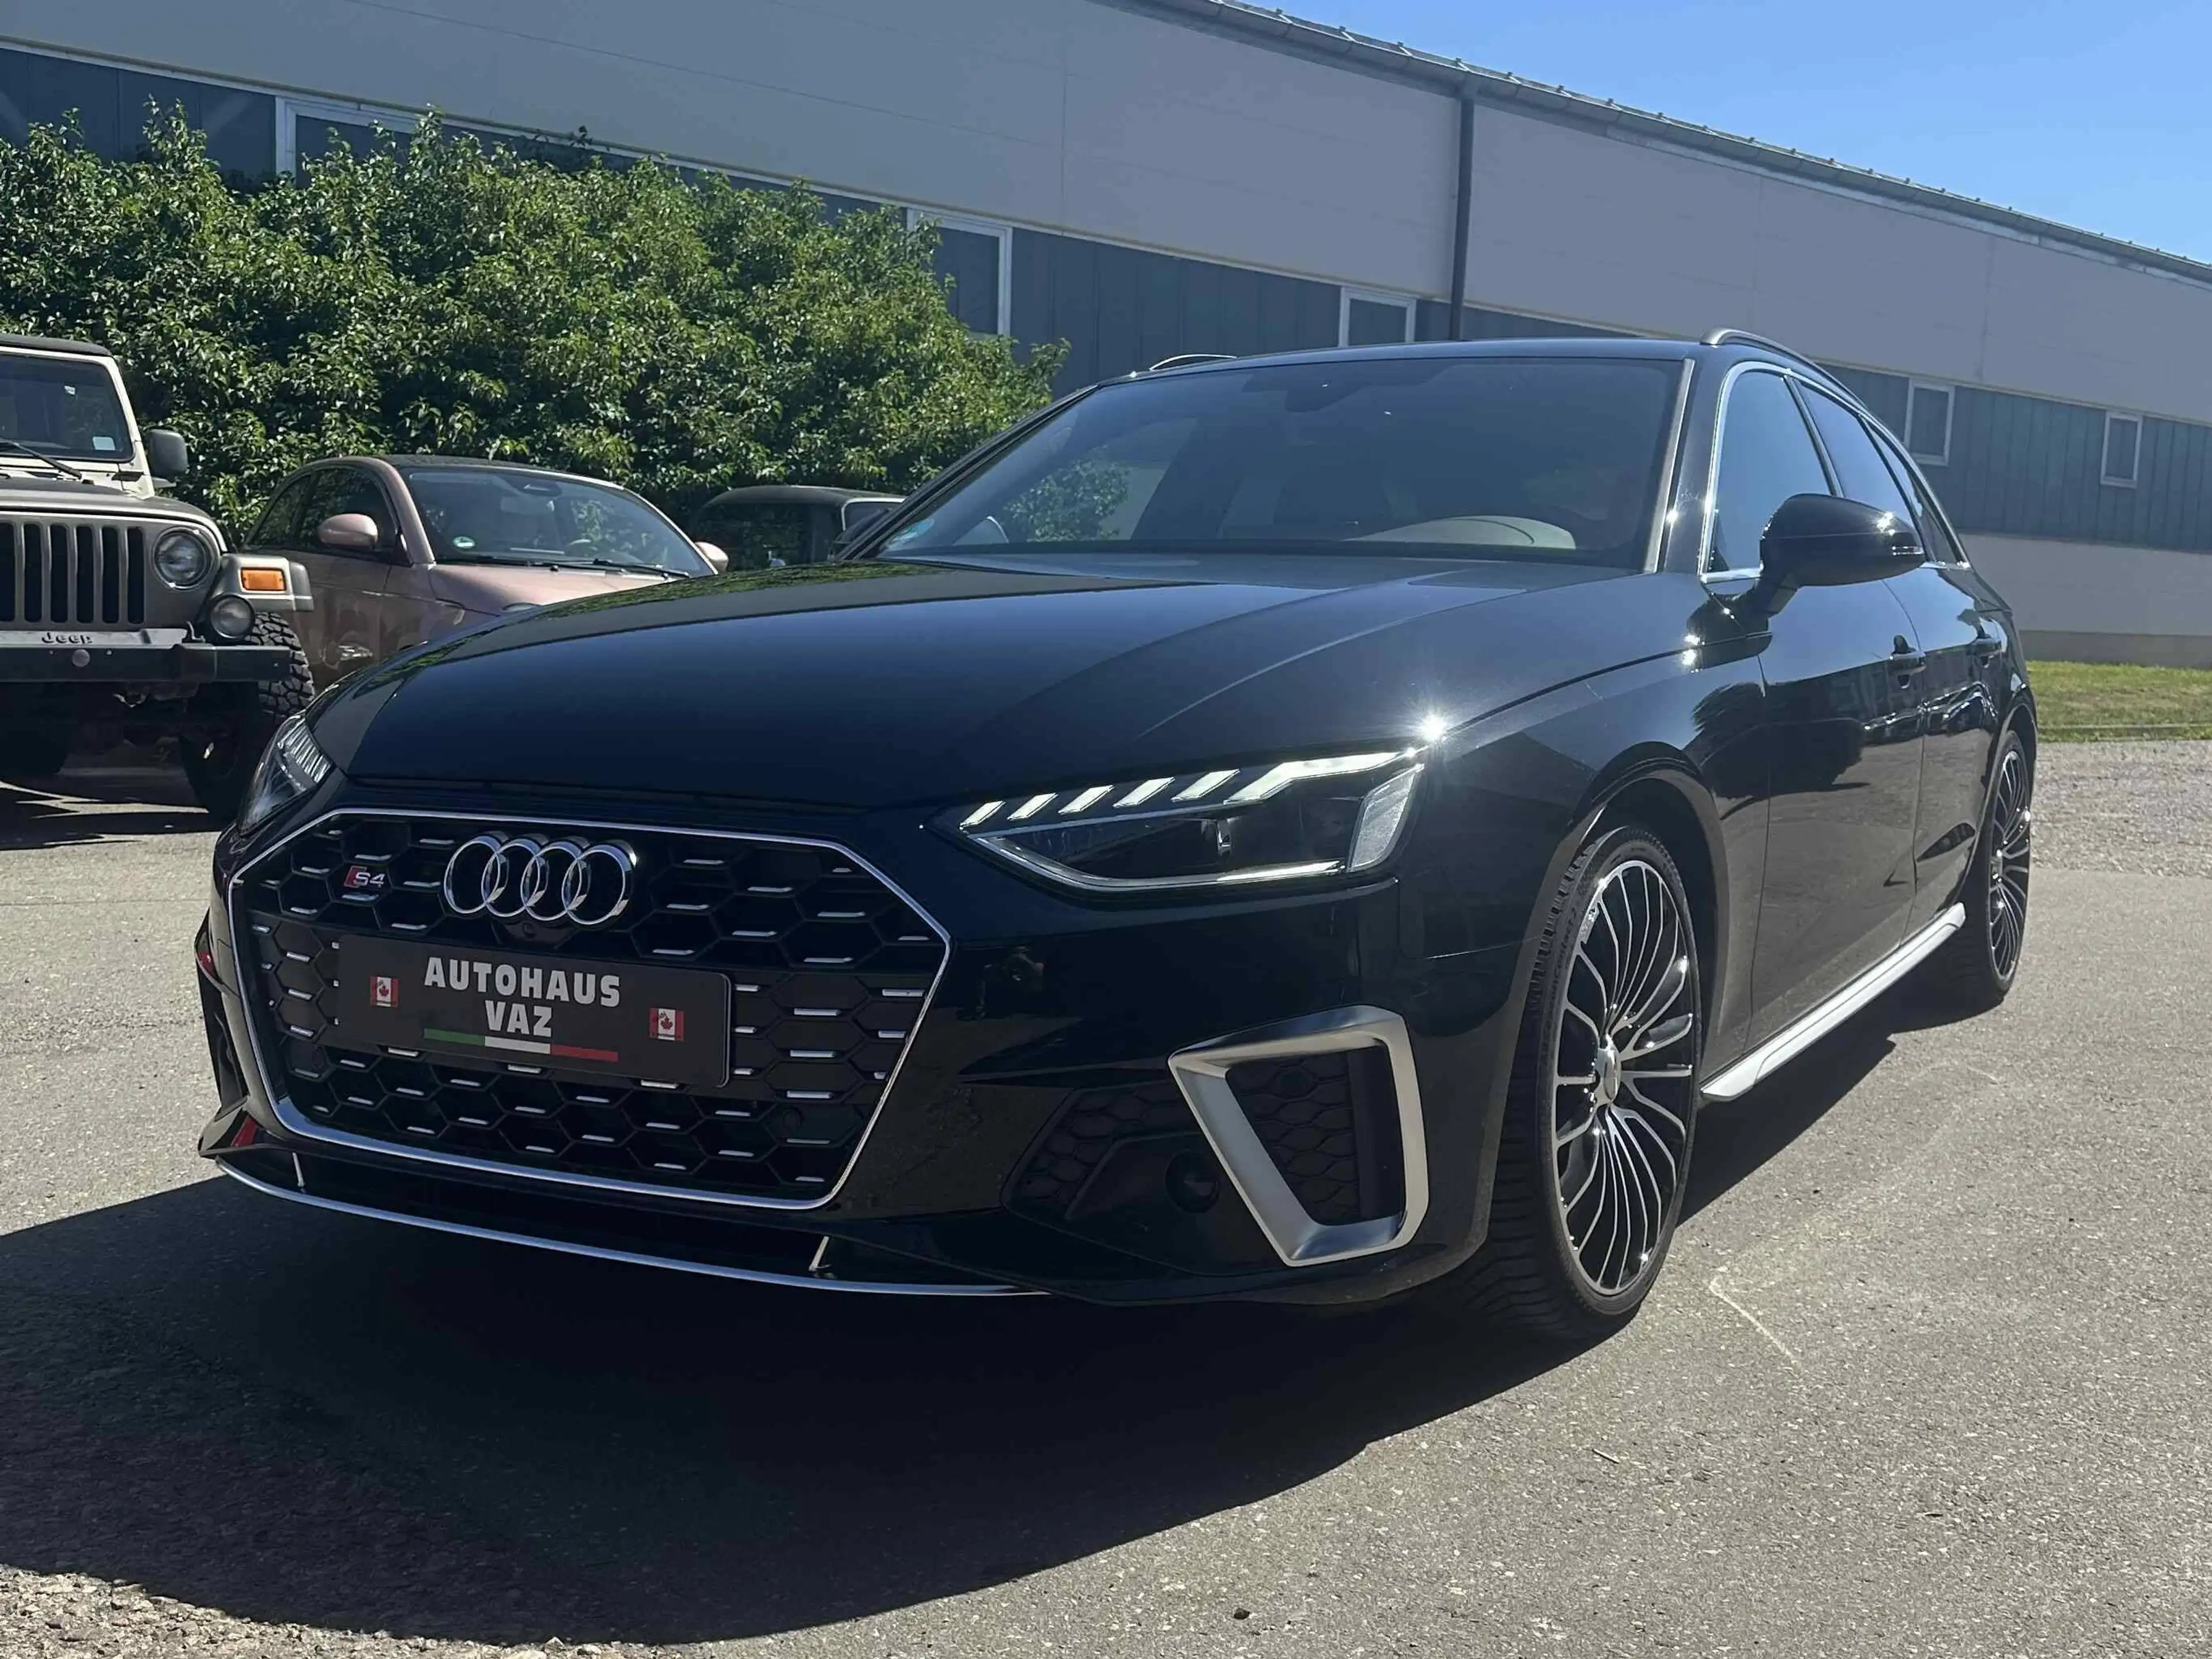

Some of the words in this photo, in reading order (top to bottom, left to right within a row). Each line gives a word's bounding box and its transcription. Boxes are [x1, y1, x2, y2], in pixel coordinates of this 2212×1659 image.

[41, 631, 93, 645] Jeep
[353, 872, 385, 888] S4
[424, 956, 621, 1008] AUTOHAUS
[485, 999, 553, 1037] VAZ
